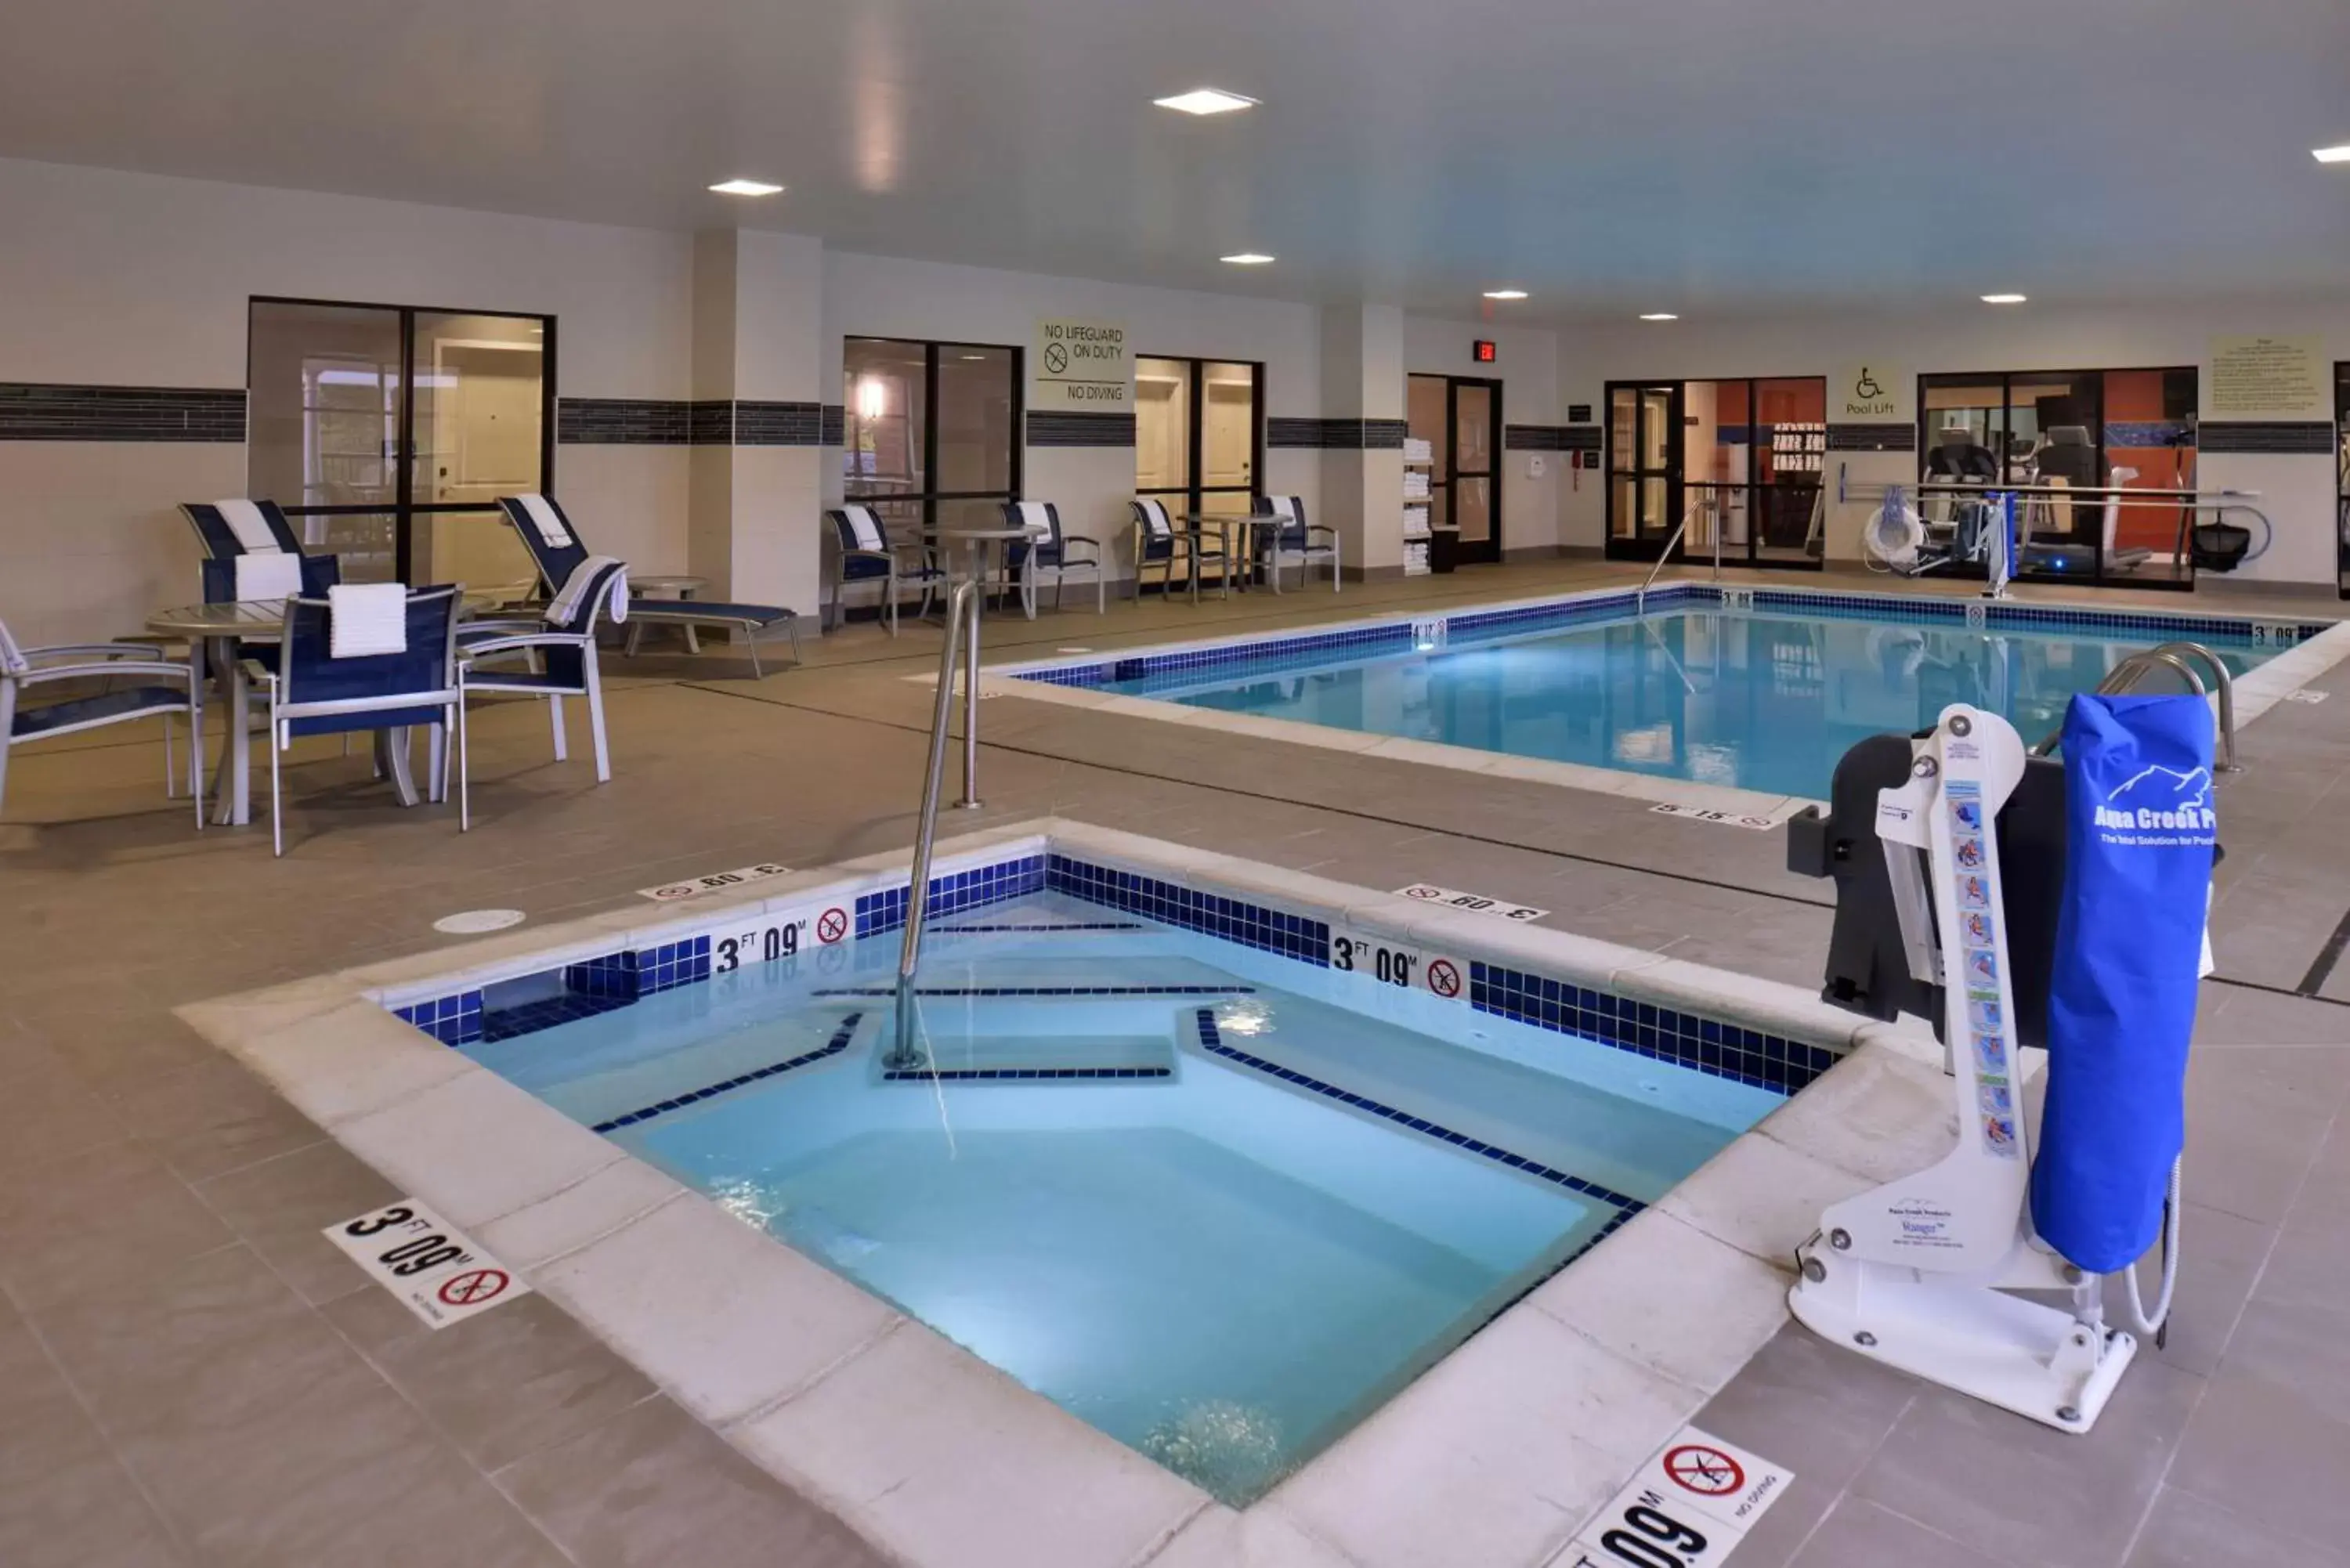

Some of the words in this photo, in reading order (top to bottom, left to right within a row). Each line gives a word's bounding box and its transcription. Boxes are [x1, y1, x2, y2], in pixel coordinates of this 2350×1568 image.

[1045, 325, 1063, 339] NO
[1066, 326, 1123, 342] LIFEGUARD
[1074, 344, 1090, 358] ON
[1094, 345, 1123, 359] DUTY
[1068, 385, 1085, 399] NO
[1086, 386, 1123, 400] DIVING
[1847, 403, 1871, 414] Pool
[1875, 403, 1894, 414] Lift
[2137, 807, 2200, 829] Creek
[717, 938, 739, 974] 3
[741, 932, 757, 948] FT
[1334, 937, 1353, 971] 3
[1355, 941, 1369, 957] FT
[345, 1207, 414, 1237] 3
[1637, 1490, 1665, 1508] M
